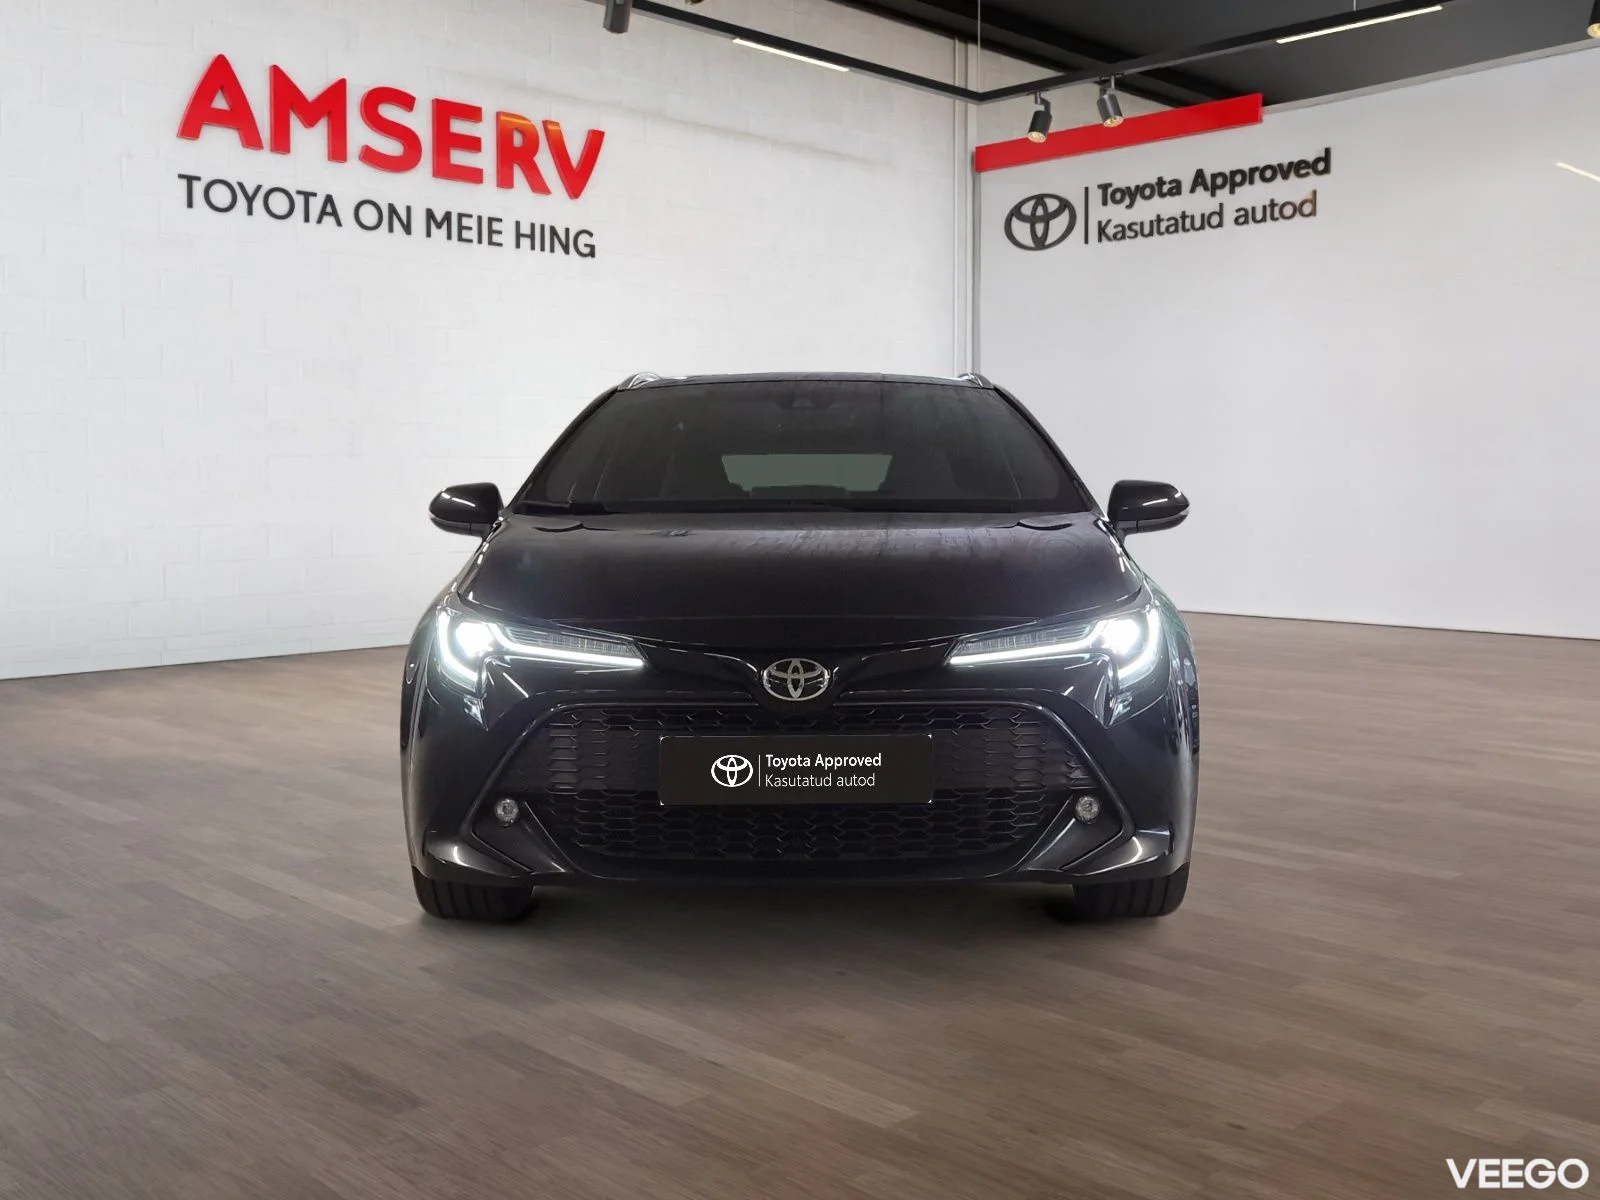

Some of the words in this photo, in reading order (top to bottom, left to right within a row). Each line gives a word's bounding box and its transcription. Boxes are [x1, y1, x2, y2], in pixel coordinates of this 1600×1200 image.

[176, 53, 606, 200] AMSERV
[1097, 175, 1182, 209] Toyota
[1189, 147, 1332, 197] Approved
[177, 173, 343, 228] TOYOTA
[353, 199, 412, 236] ON
[425, 207, 503, 247] MEIE
[515, 221, 596, 258] HING
[1096, 202, 1225, 244] Kasutatud
[1233, 189, 1318, 225] autod
[765, 753, 811, 770] Toyota
[814, 752, 882, 770] Approved
[765, 773, 832, 788] Kasutatud
[836, 773, 876, 788] autod
